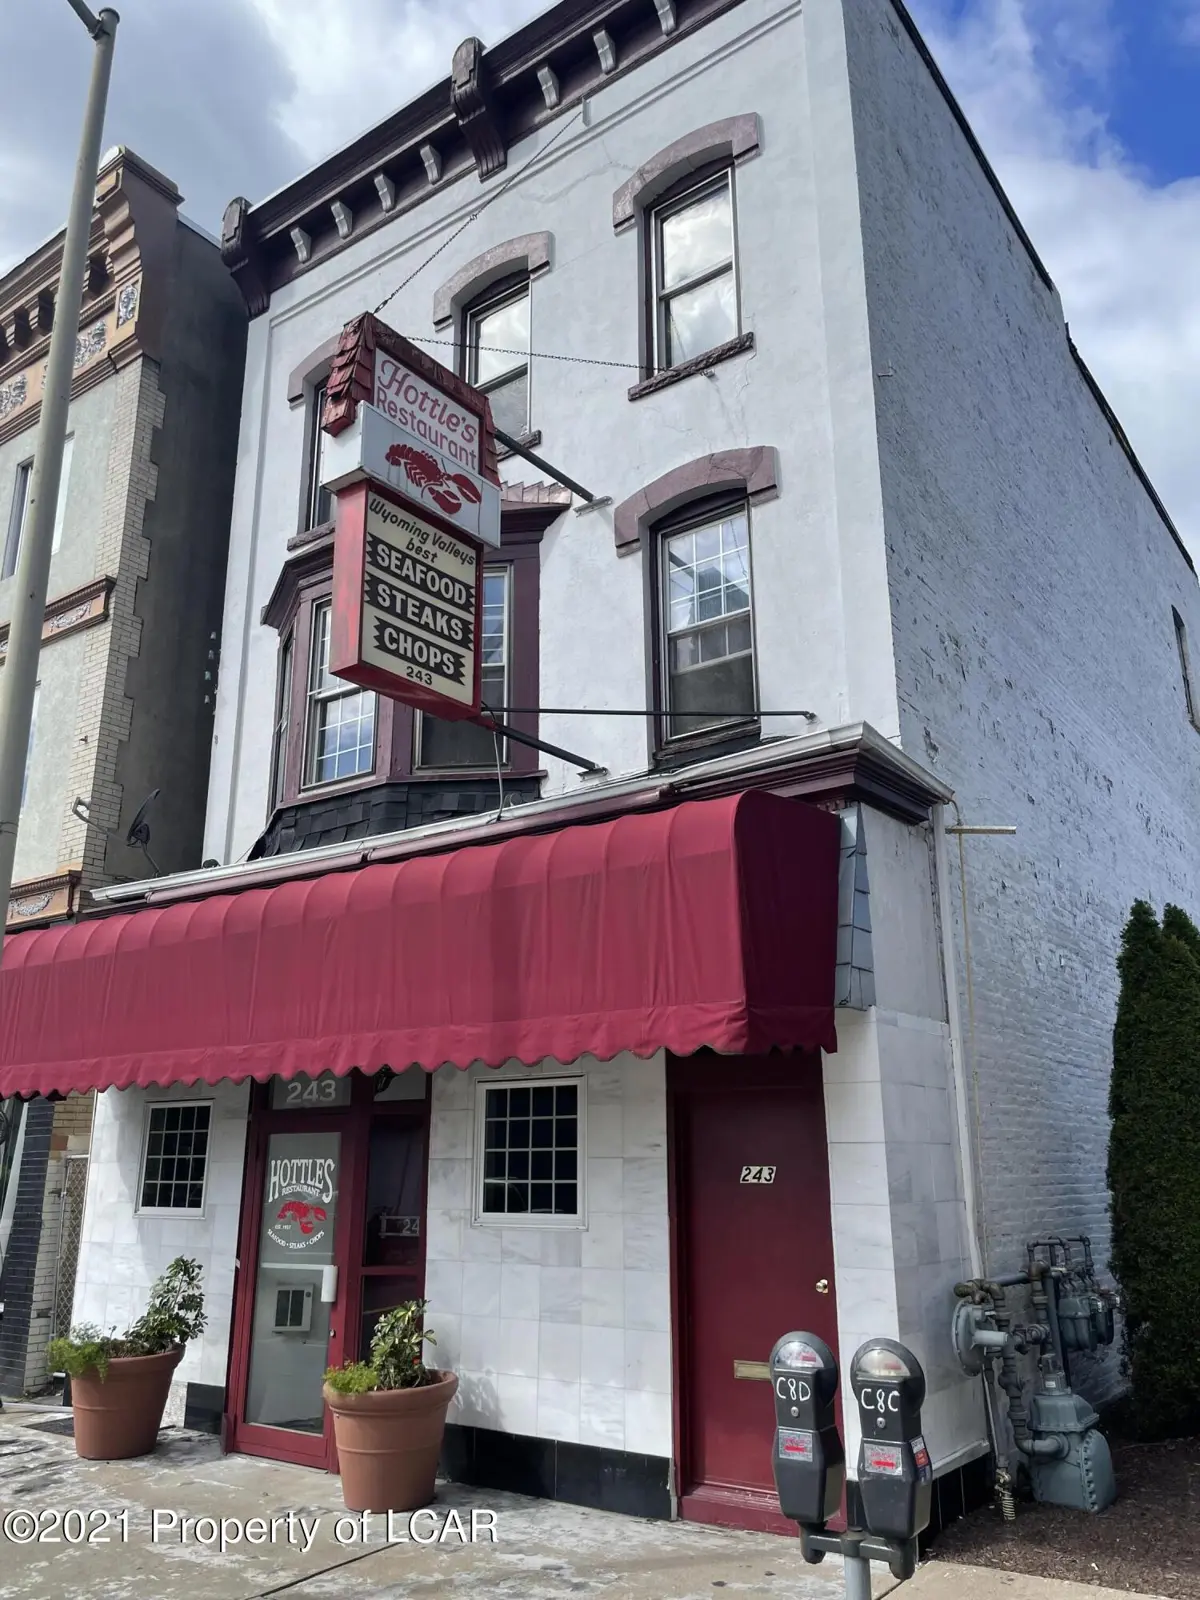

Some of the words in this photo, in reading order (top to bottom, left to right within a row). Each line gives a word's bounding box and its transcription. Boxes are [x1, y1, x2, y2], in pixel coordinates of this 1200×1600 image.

[377, 359, 477, 444] Hottle's
[375, 385, 477, 471] Restaurant
[369, 497, 430, 545] Wyoming
[432, 533, 475, 566] Valleys
[405, 537, 438, 564] best
[376, 543, 467, 605] SEAFOOD
[377, 583, 464, 641] STEAKS
[383, 627, 455, 675] CHOPS
[405, 665, 433, 686] 243
[286, 1079, 336, 1103] 243
[268, 1158, 335, 1203] HOTTLES
[281, 1183, 321, 1197] RESTAURANT
[741, 1166, 775, 1182] 243
[776, 1377, 811, 1401] C8D
[861, 1388, 900, 1413] C8C
